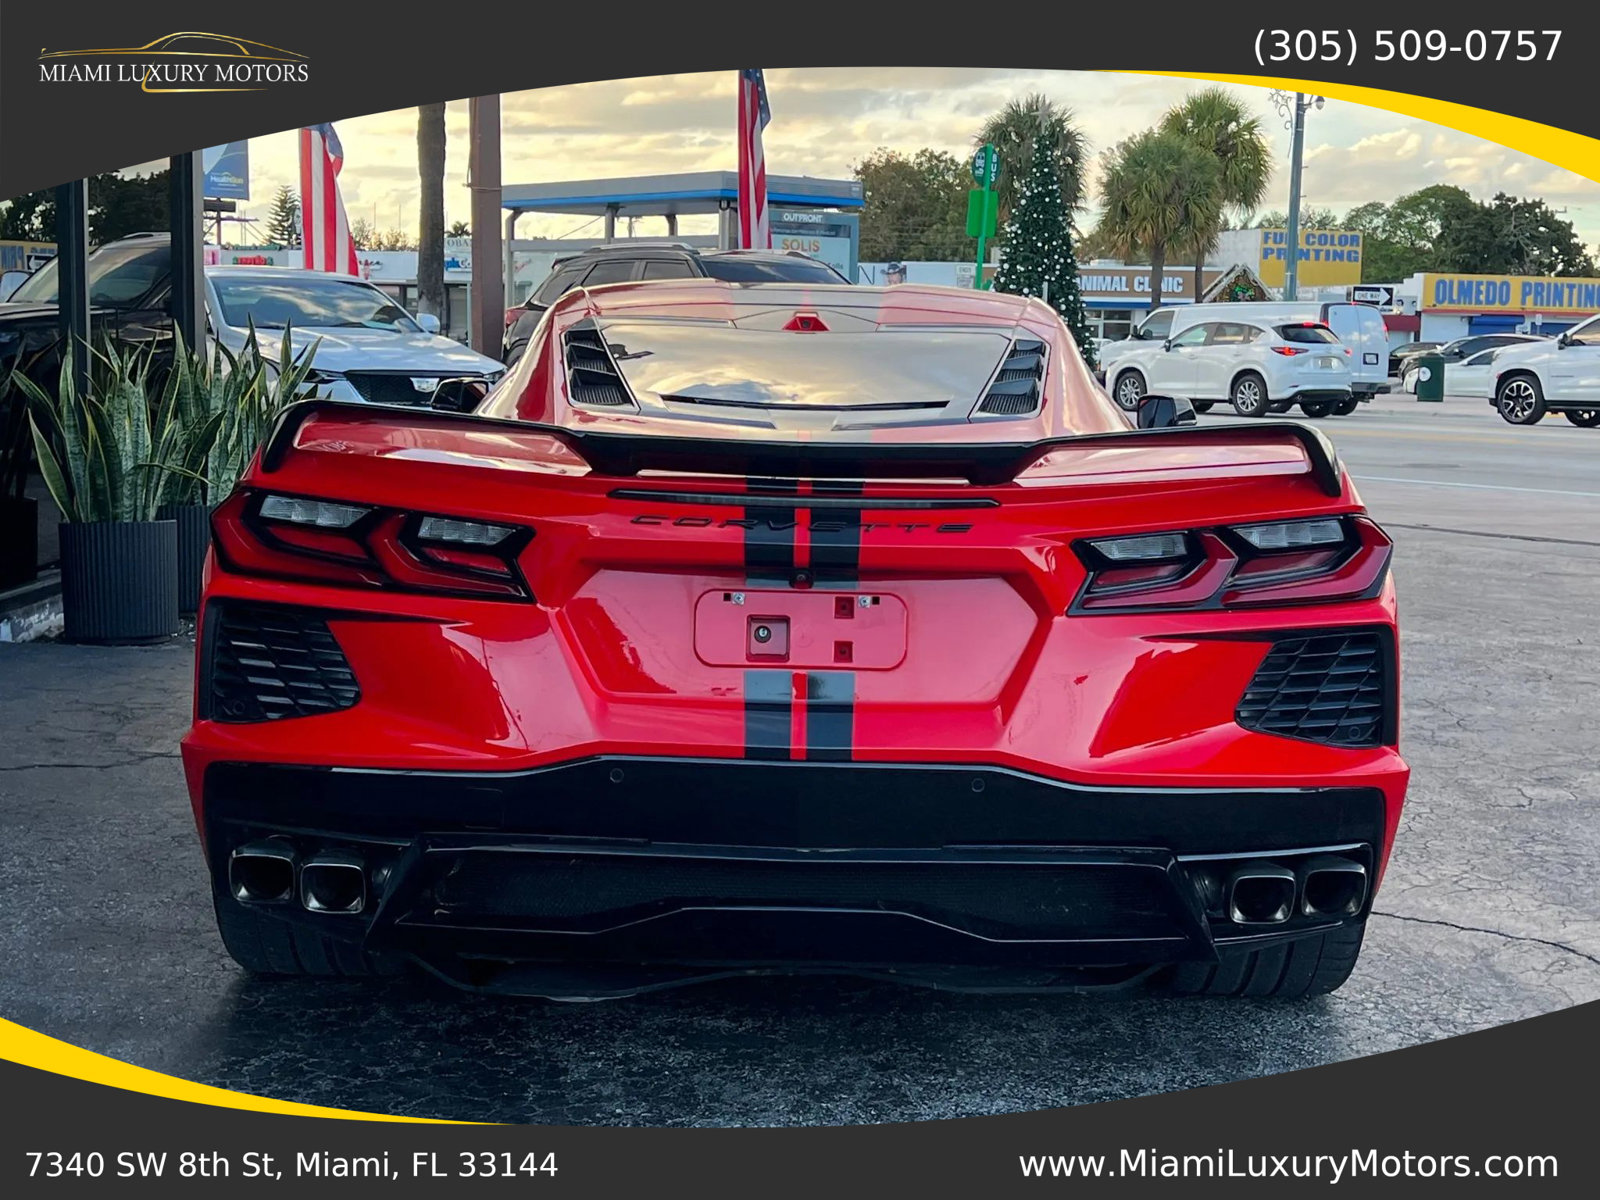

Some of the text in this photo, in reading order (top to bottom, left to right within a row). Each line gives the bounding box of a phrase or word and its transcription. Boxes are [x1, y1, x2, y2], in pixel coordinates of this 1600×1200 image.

[783, 212, 823, 223] OUTFRONT
[781, 238, 820, 252] SOLIS
[1305, 233, 1361, 247] COLOR
[1262, 247, 1360, 262] PRNTING
[1133, 276, 1183, 293] CLNIC
[1434, 279, 1511, 306] OLMEDO
[630, 514, 975, 534] CORVETTE
